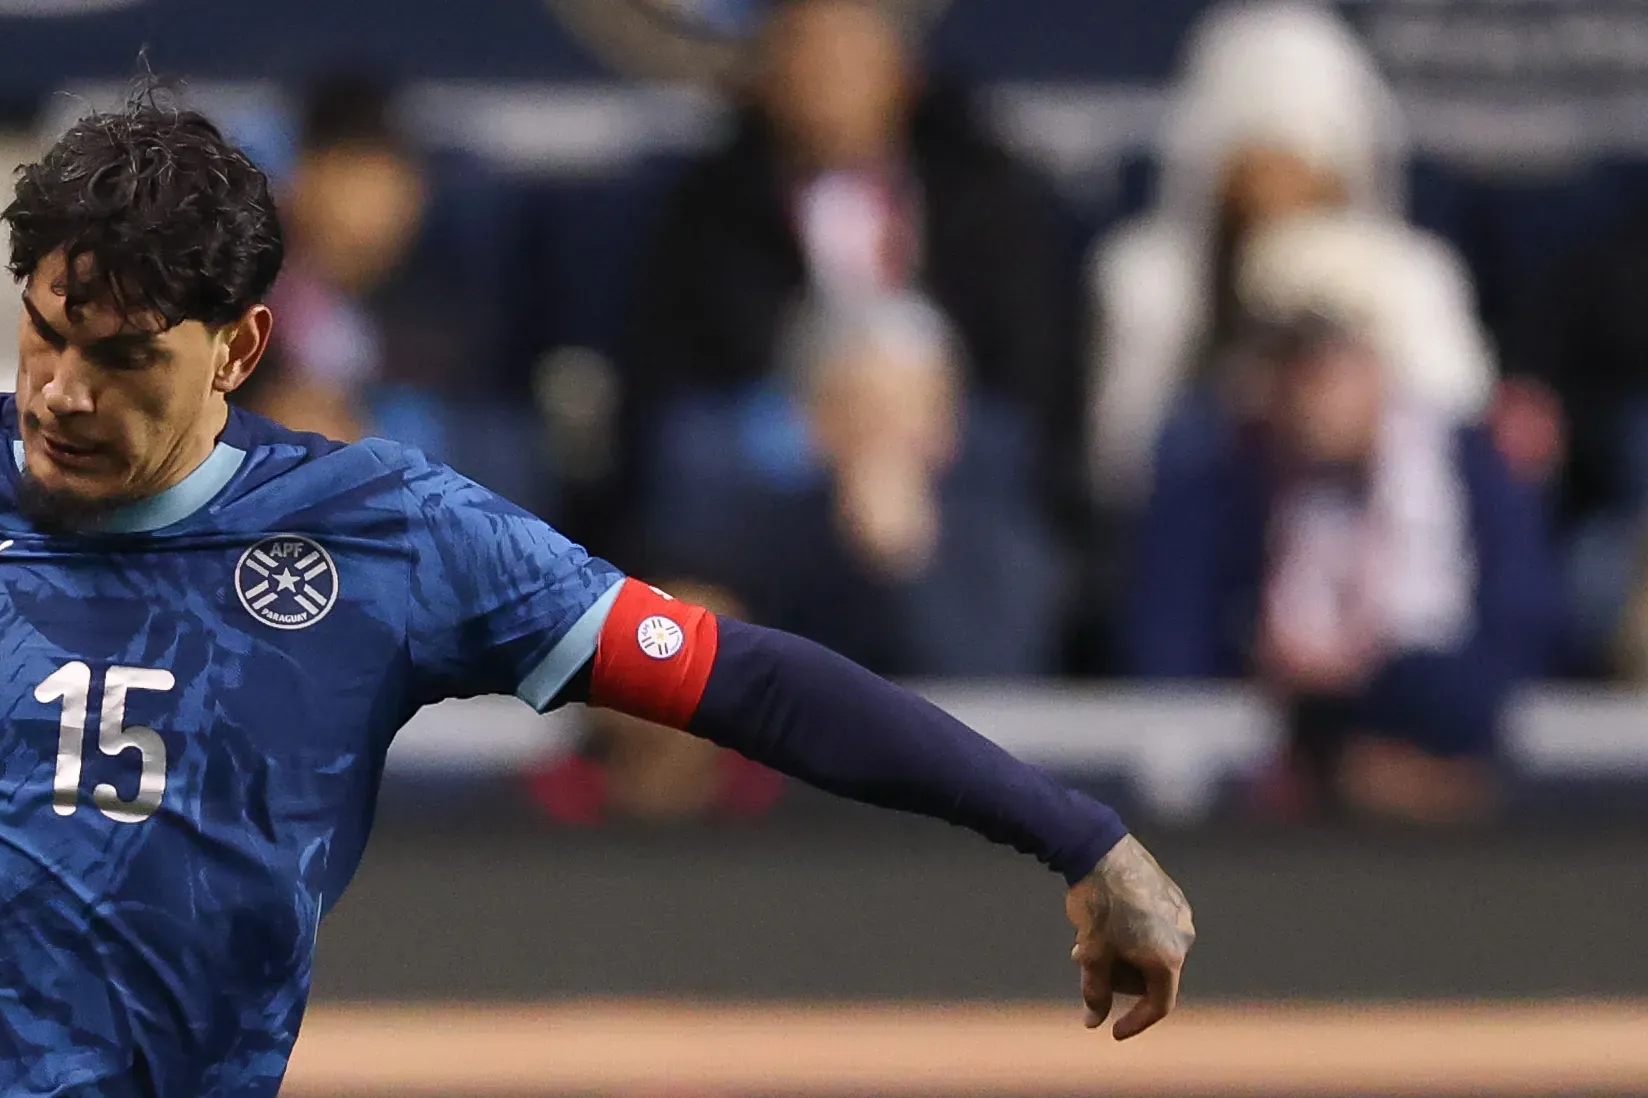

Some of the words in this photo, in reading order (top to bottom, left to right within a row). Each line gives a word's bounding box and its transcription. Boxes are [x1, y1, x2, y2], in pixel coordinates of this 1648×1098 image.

[270, 542, 304, 557] APF
[261, 607, 308, 623] PARAGUAY
[34, 660, 175, 823] 15
